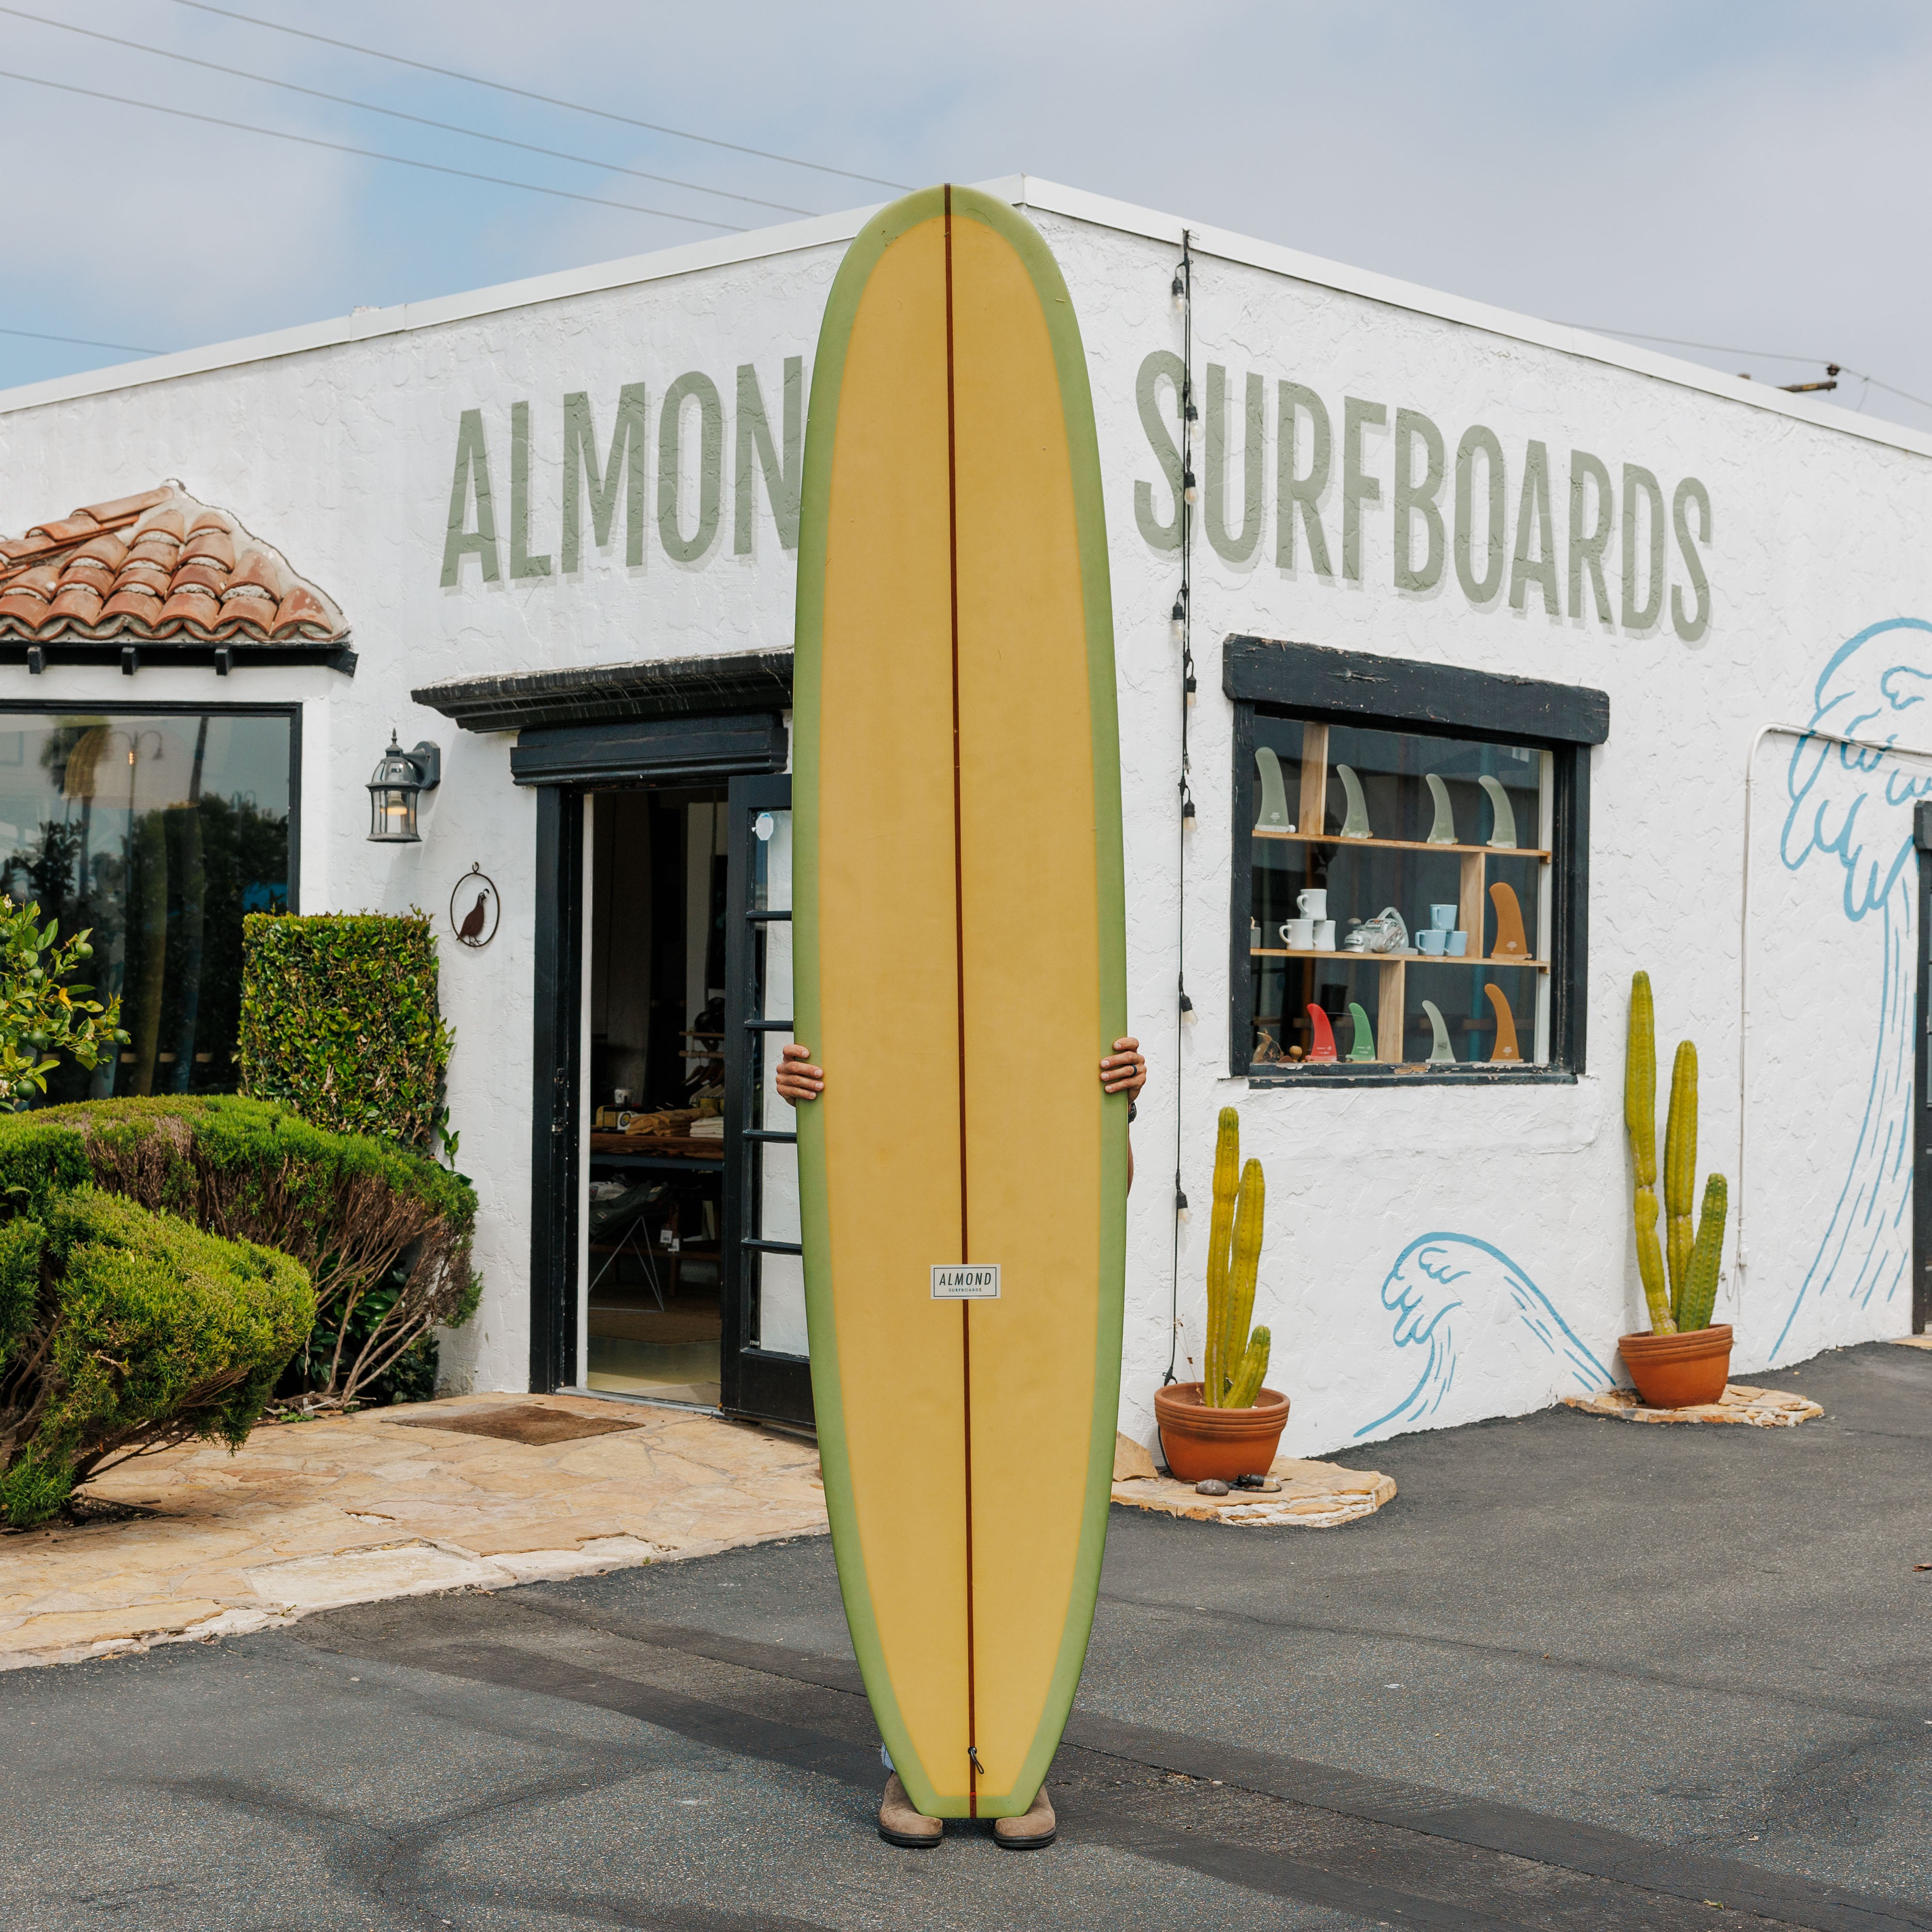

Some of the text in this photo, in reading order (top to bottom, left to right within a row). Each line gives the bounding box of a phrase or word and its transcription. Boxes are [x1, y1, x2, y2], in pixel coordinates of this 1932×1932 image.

[440, 350, 1712, 643] ALMON SURFBOARDS
[939, 1273, 992, 1285] ALMOND
